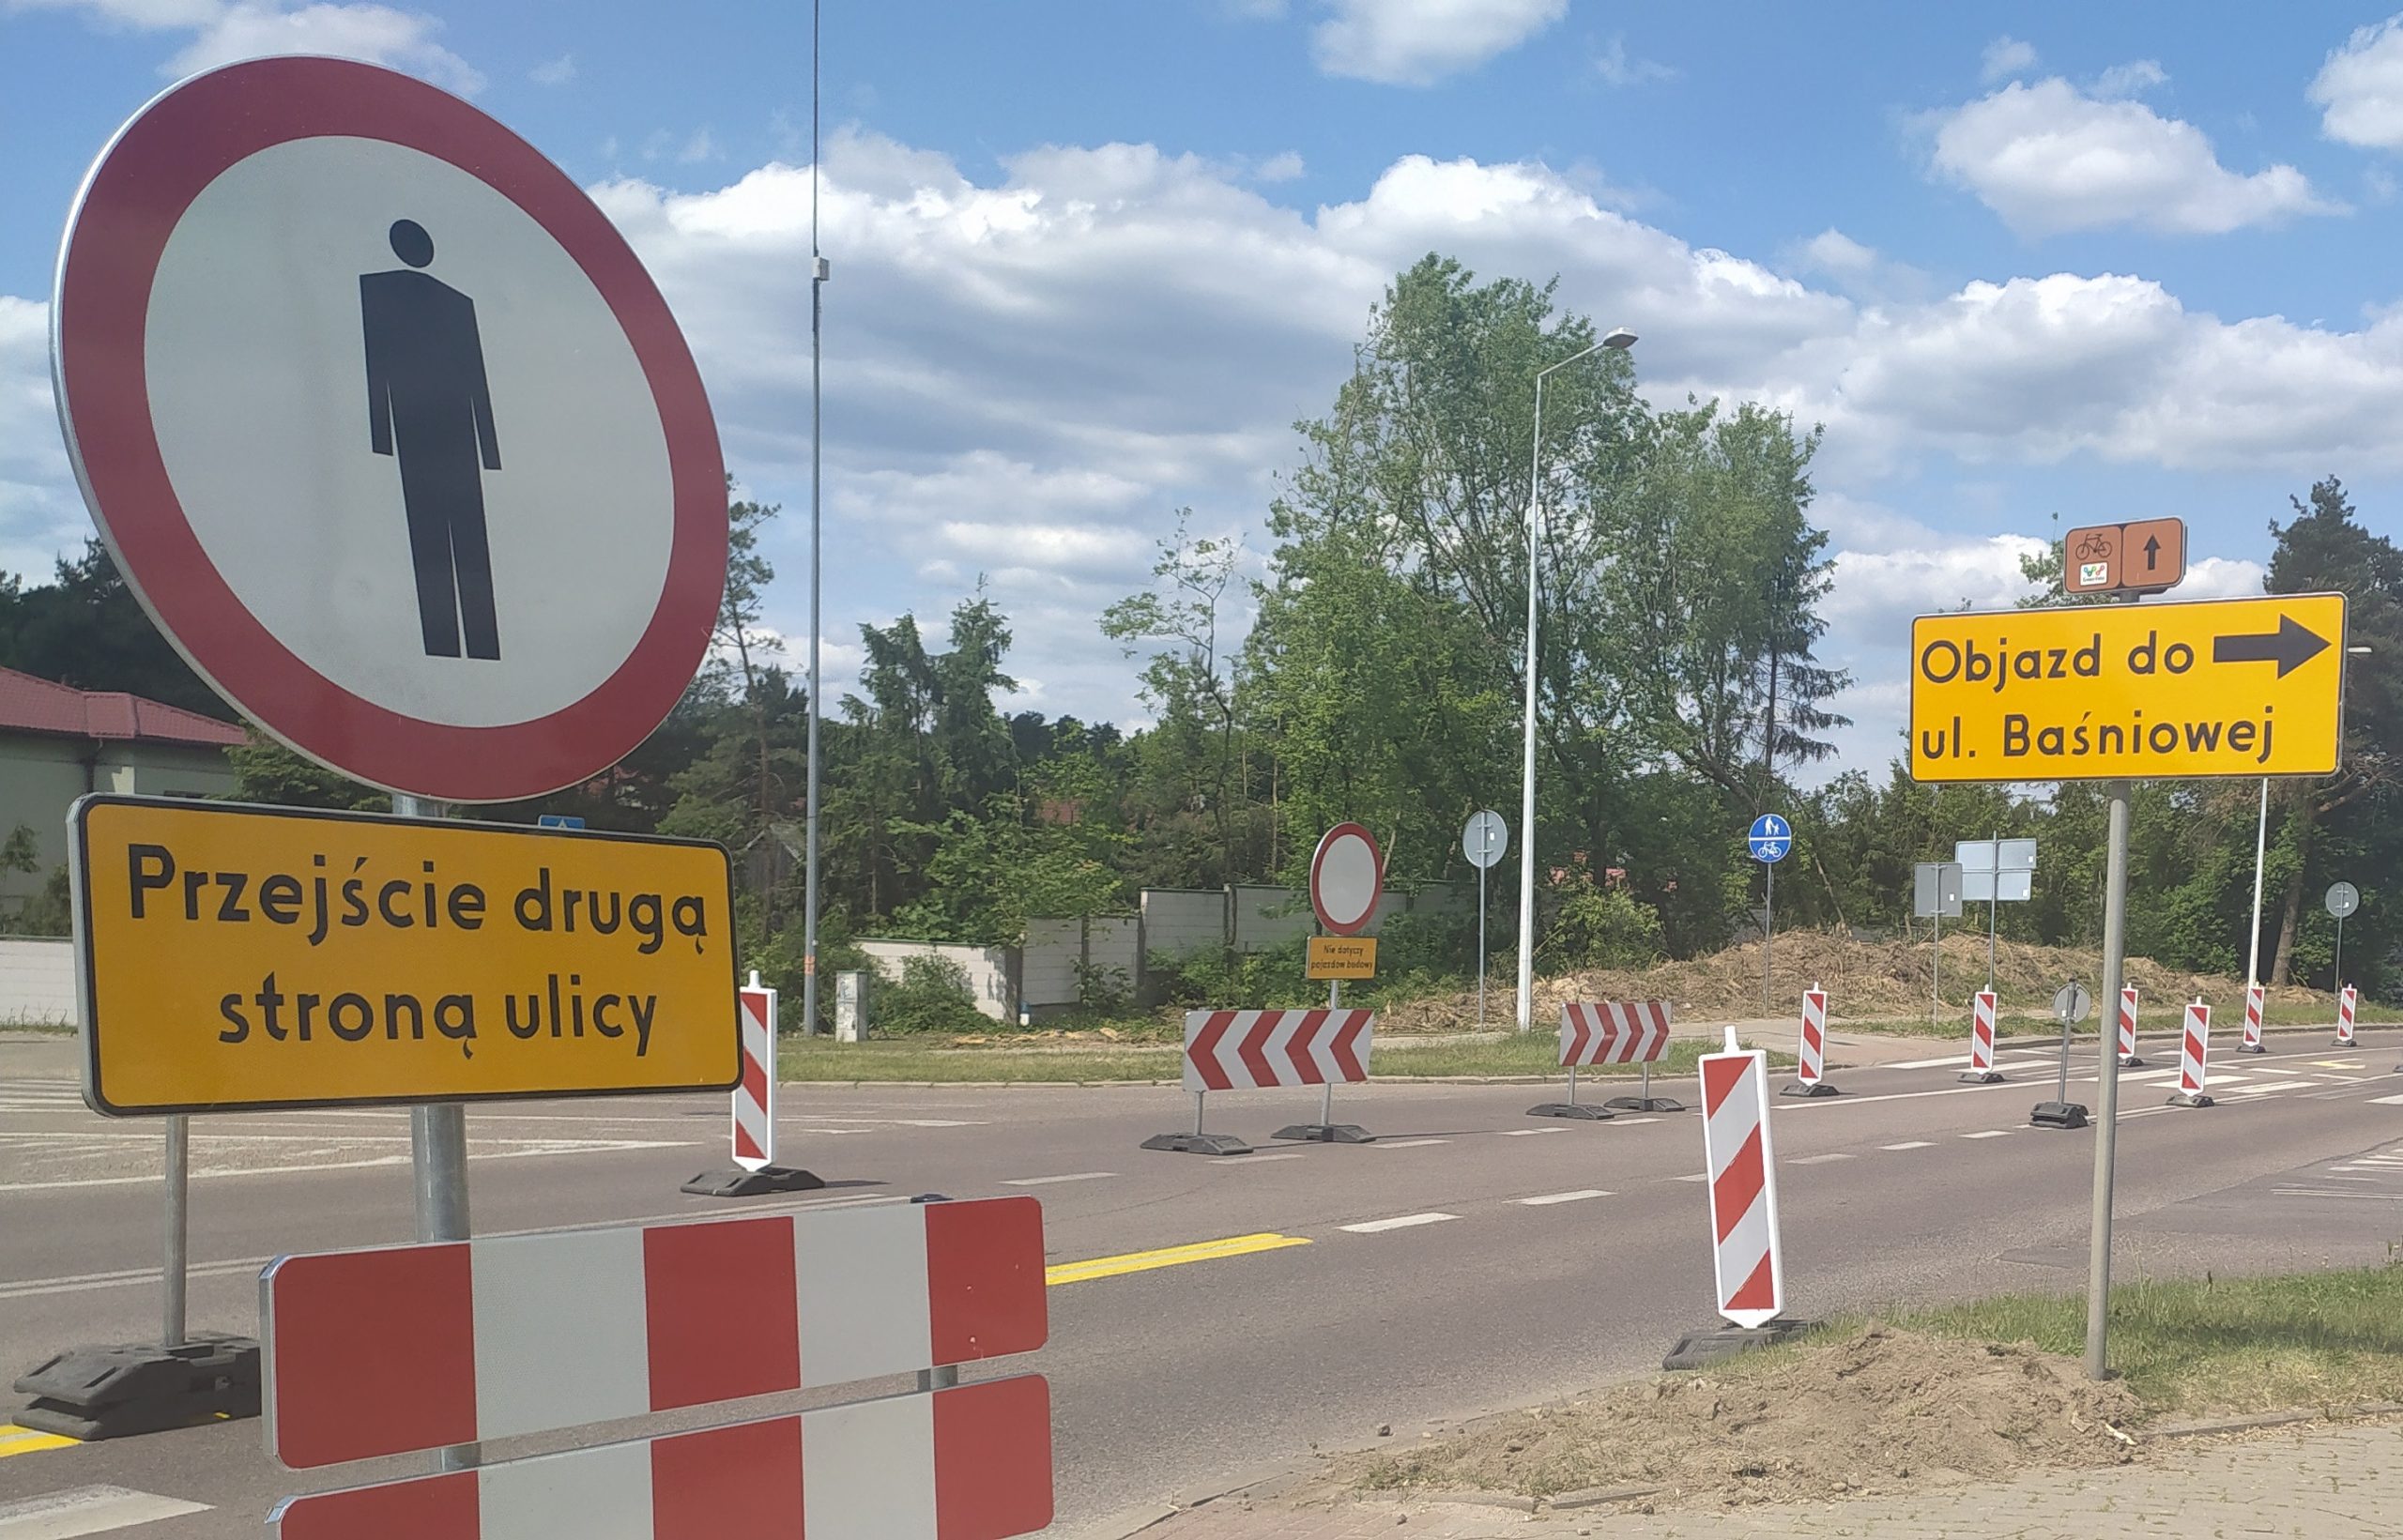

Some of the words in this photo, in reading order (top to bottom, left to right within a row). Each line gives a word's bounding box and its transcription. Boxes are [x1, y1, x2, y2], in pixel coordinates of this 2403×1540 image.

[1921, 633, 2101, 694] Objazd
[2128, 630, 2195, 675] do
[1922, 716, 1976, 759] ul.
[2003, 705, 2273, 764] Baśniowej
[128, 843, 486, 947] Przejście
[513, 867, 708, 955] drugą
[218, 970, 478, 1060] stroną
[505, 973, 657, 1057] ulicy
